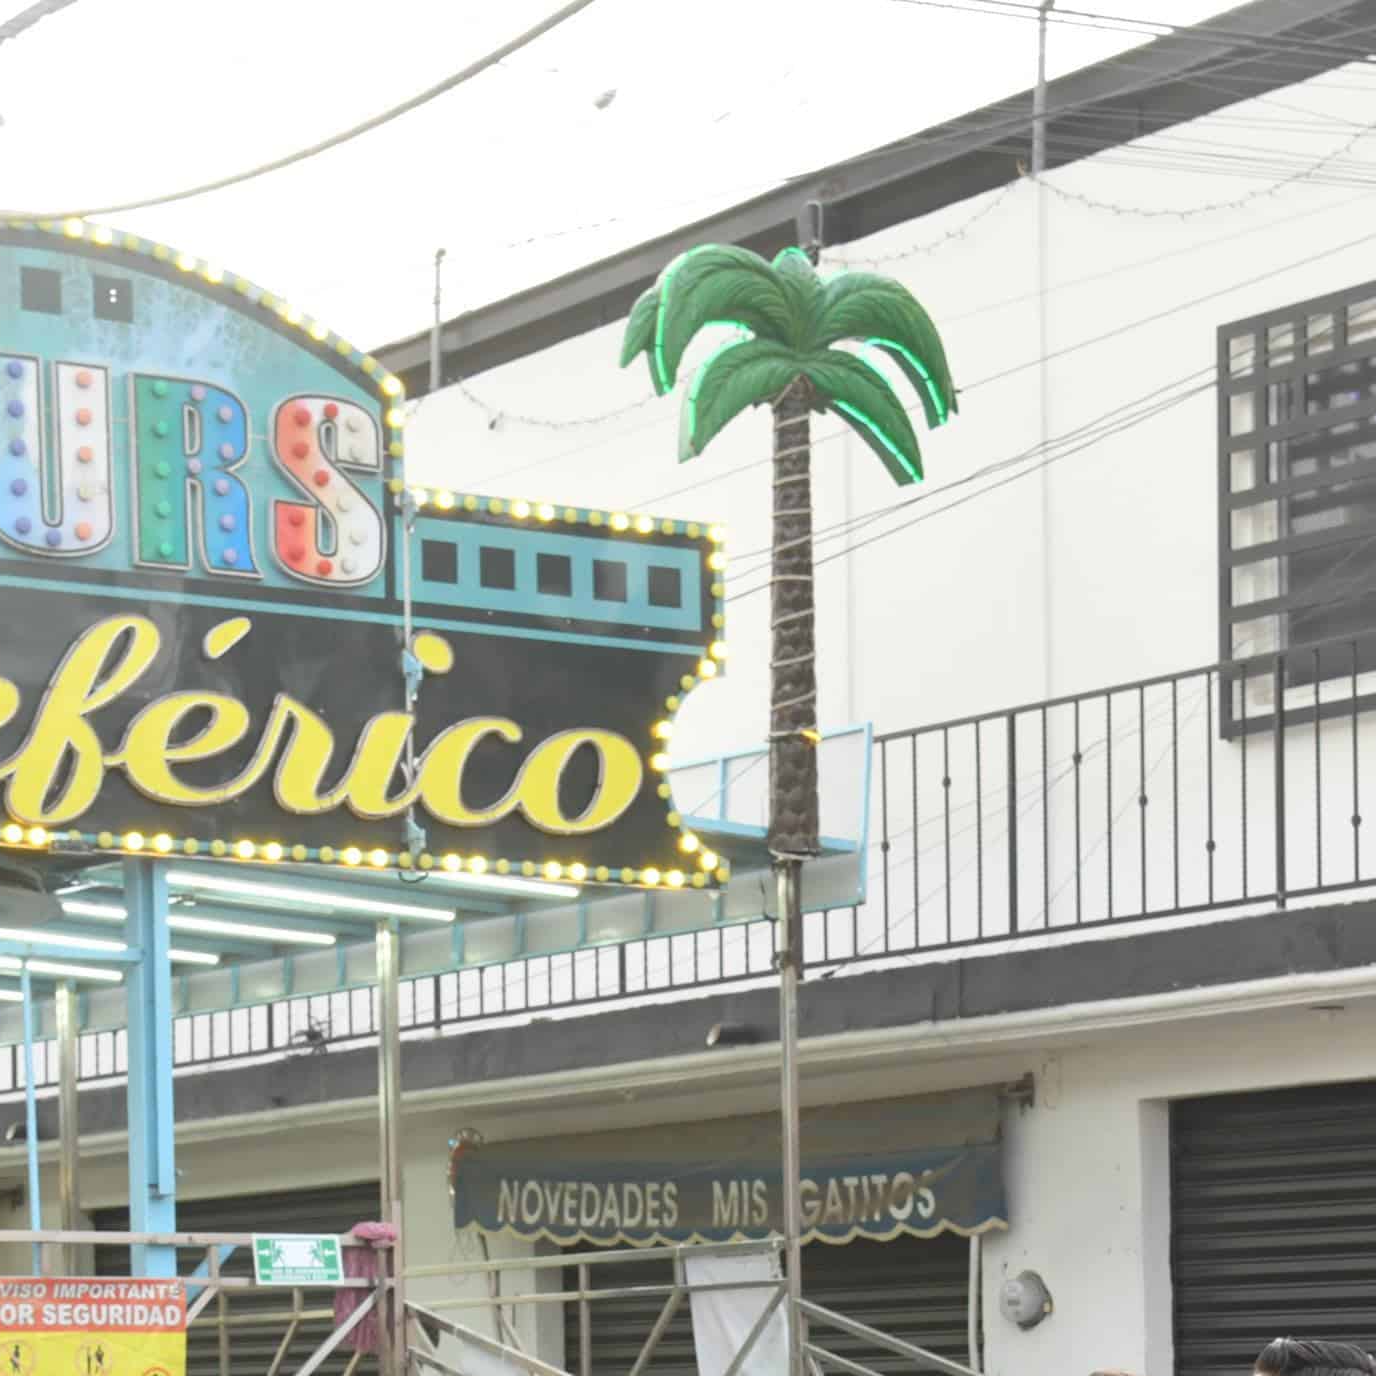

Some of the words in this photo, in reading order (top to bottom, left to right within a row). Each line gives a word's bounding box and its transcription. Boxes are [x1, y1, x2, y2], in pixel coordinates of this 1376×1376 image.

[496, 1179, 679, 1229] NOVEDADES
[711, 1180, 768, 1225] MIS
[798, 1170, 937, 1226] GATITOS
[52, 1284, 181, 1299] IMPORTANTE
[42, 1304, 181, 1326] SEGURIDAD
